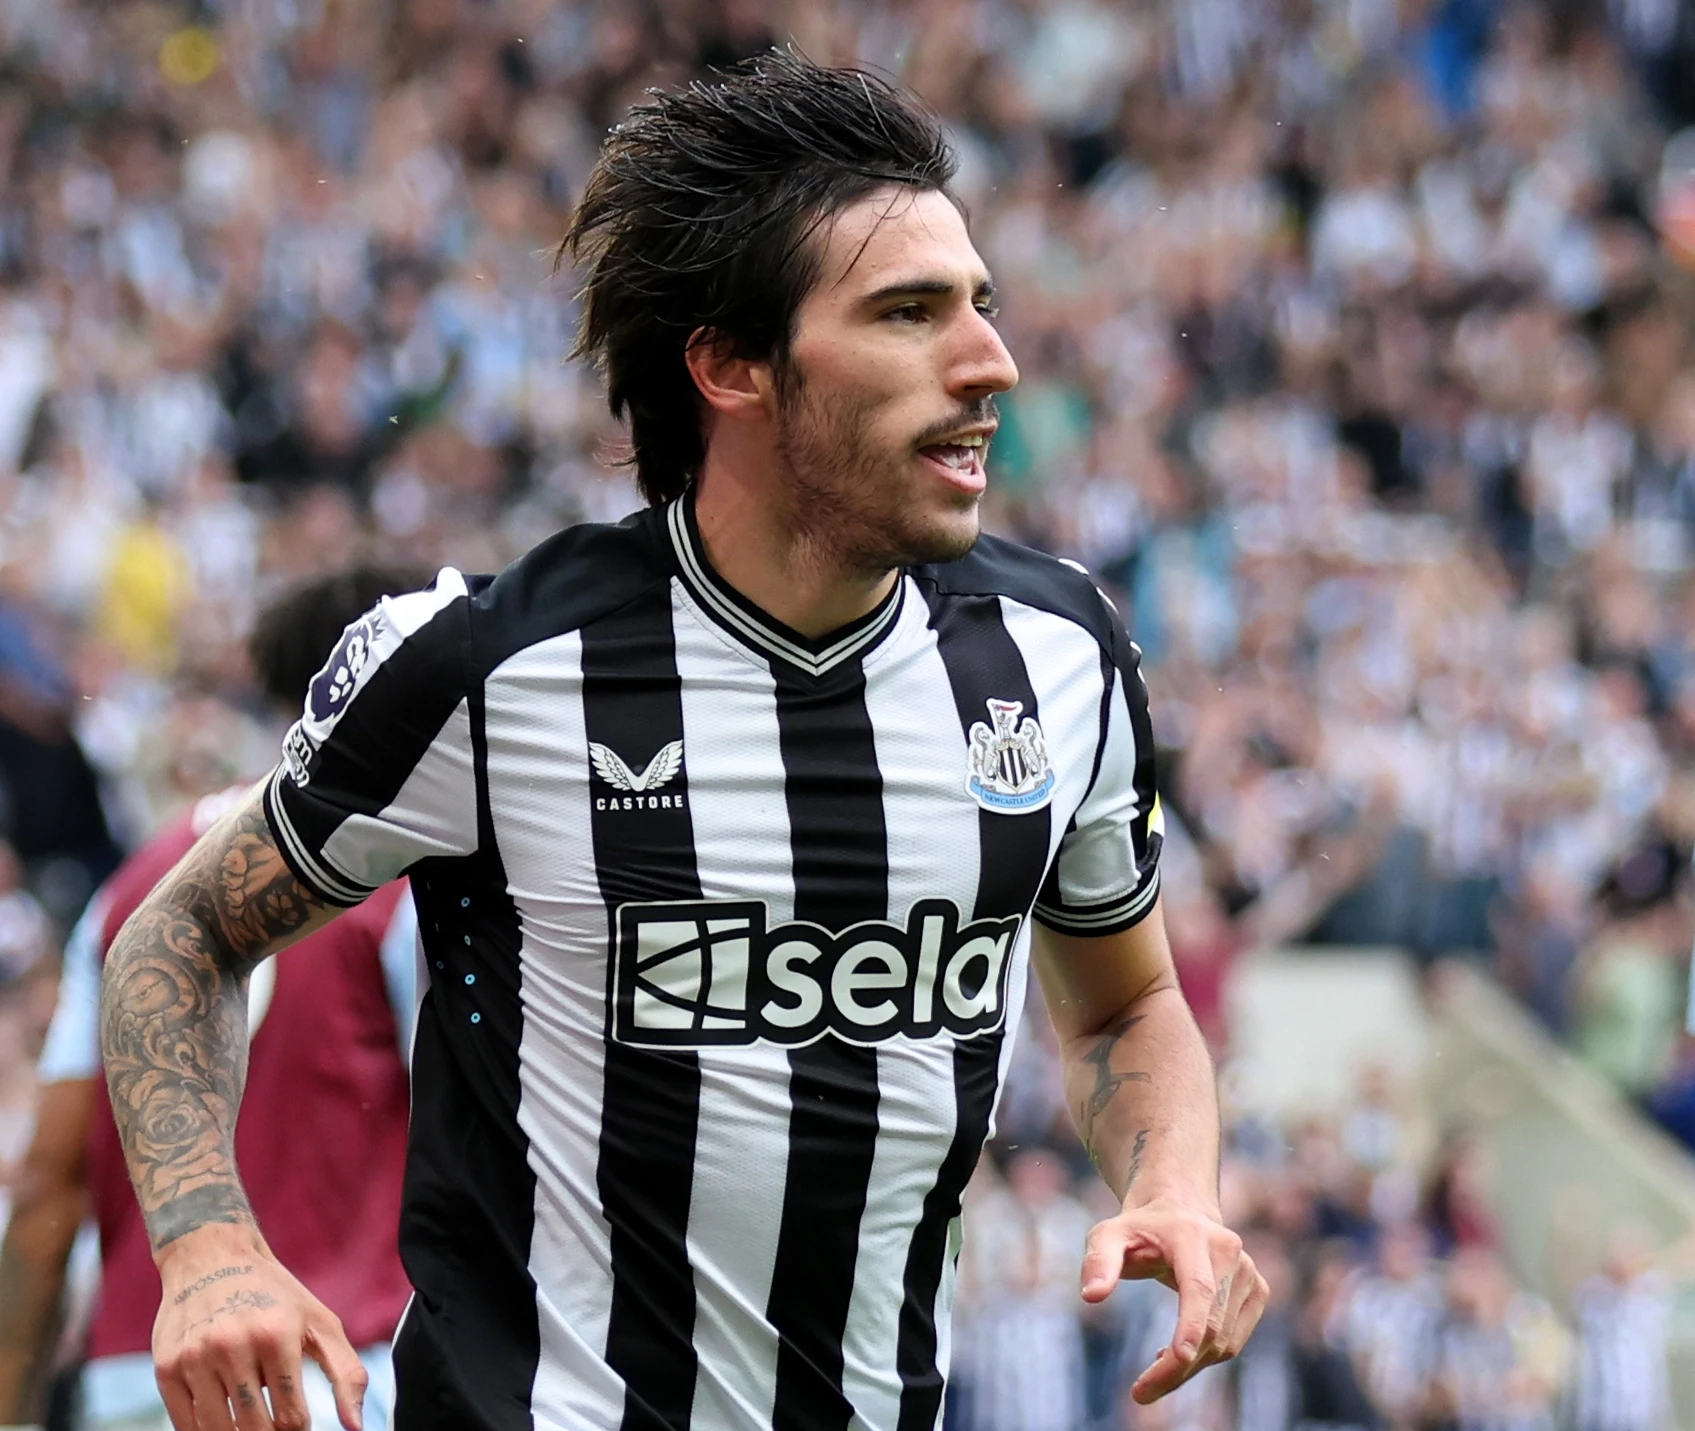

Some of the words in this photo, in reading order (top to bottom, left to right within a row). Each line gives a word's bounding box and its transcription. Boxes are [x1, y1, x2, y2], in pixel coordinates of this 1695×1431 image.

[596, 794, 684, 811] CASTORE
[984, 793, 1024, 805] NEWCASTLE
[1024, 788, 1046, 802] UNITED
[760, 915, 1011, 1029] sela
